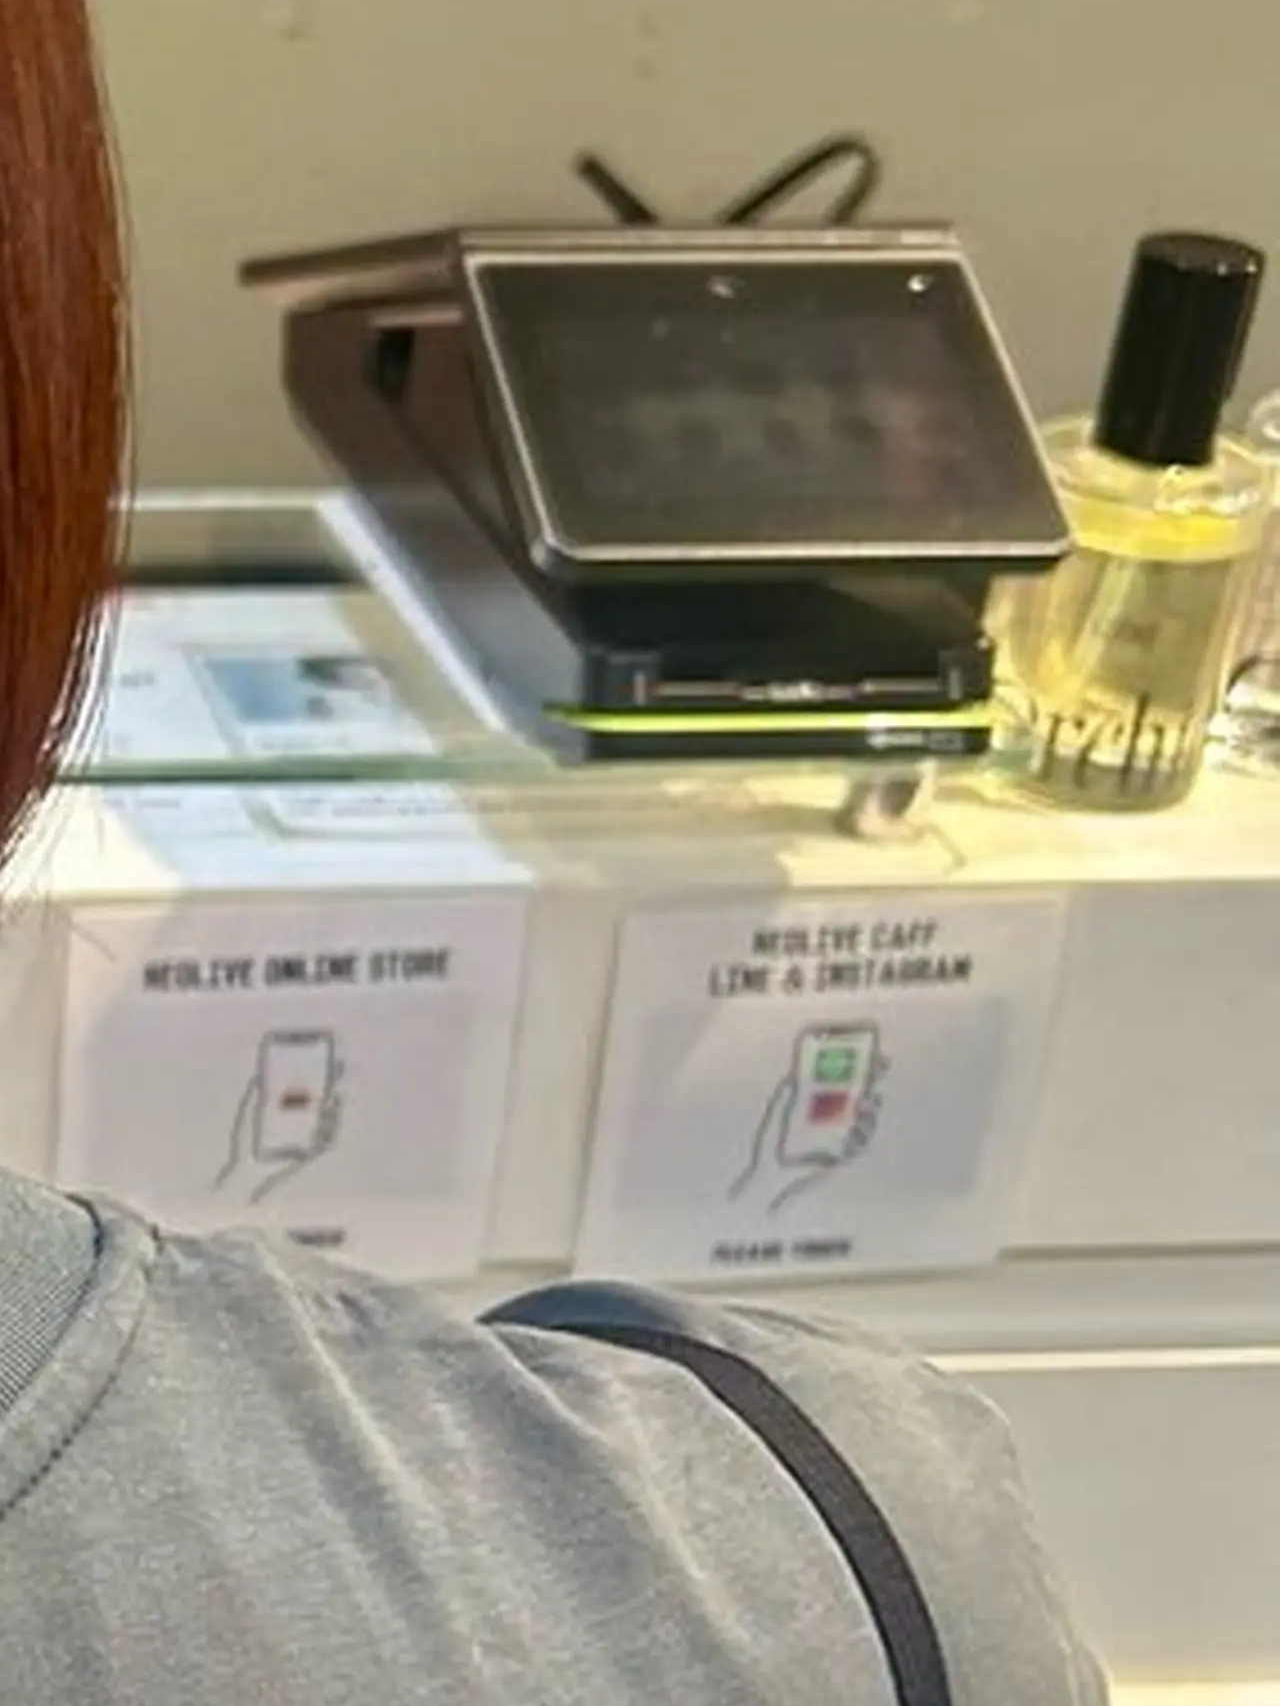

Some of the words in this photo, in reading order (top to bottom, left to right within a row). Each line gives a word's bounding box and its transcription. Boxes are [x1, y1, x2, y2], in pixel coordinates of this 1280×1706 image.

[143, 955, 253, 991] NEOLIVE
[263, 951, 358, 988] ONLINE
[366, 946, 449, 983] STORE
[706, 961, 769, 997] LINE
[812, 952, 971, 992] INSTAGRAM
